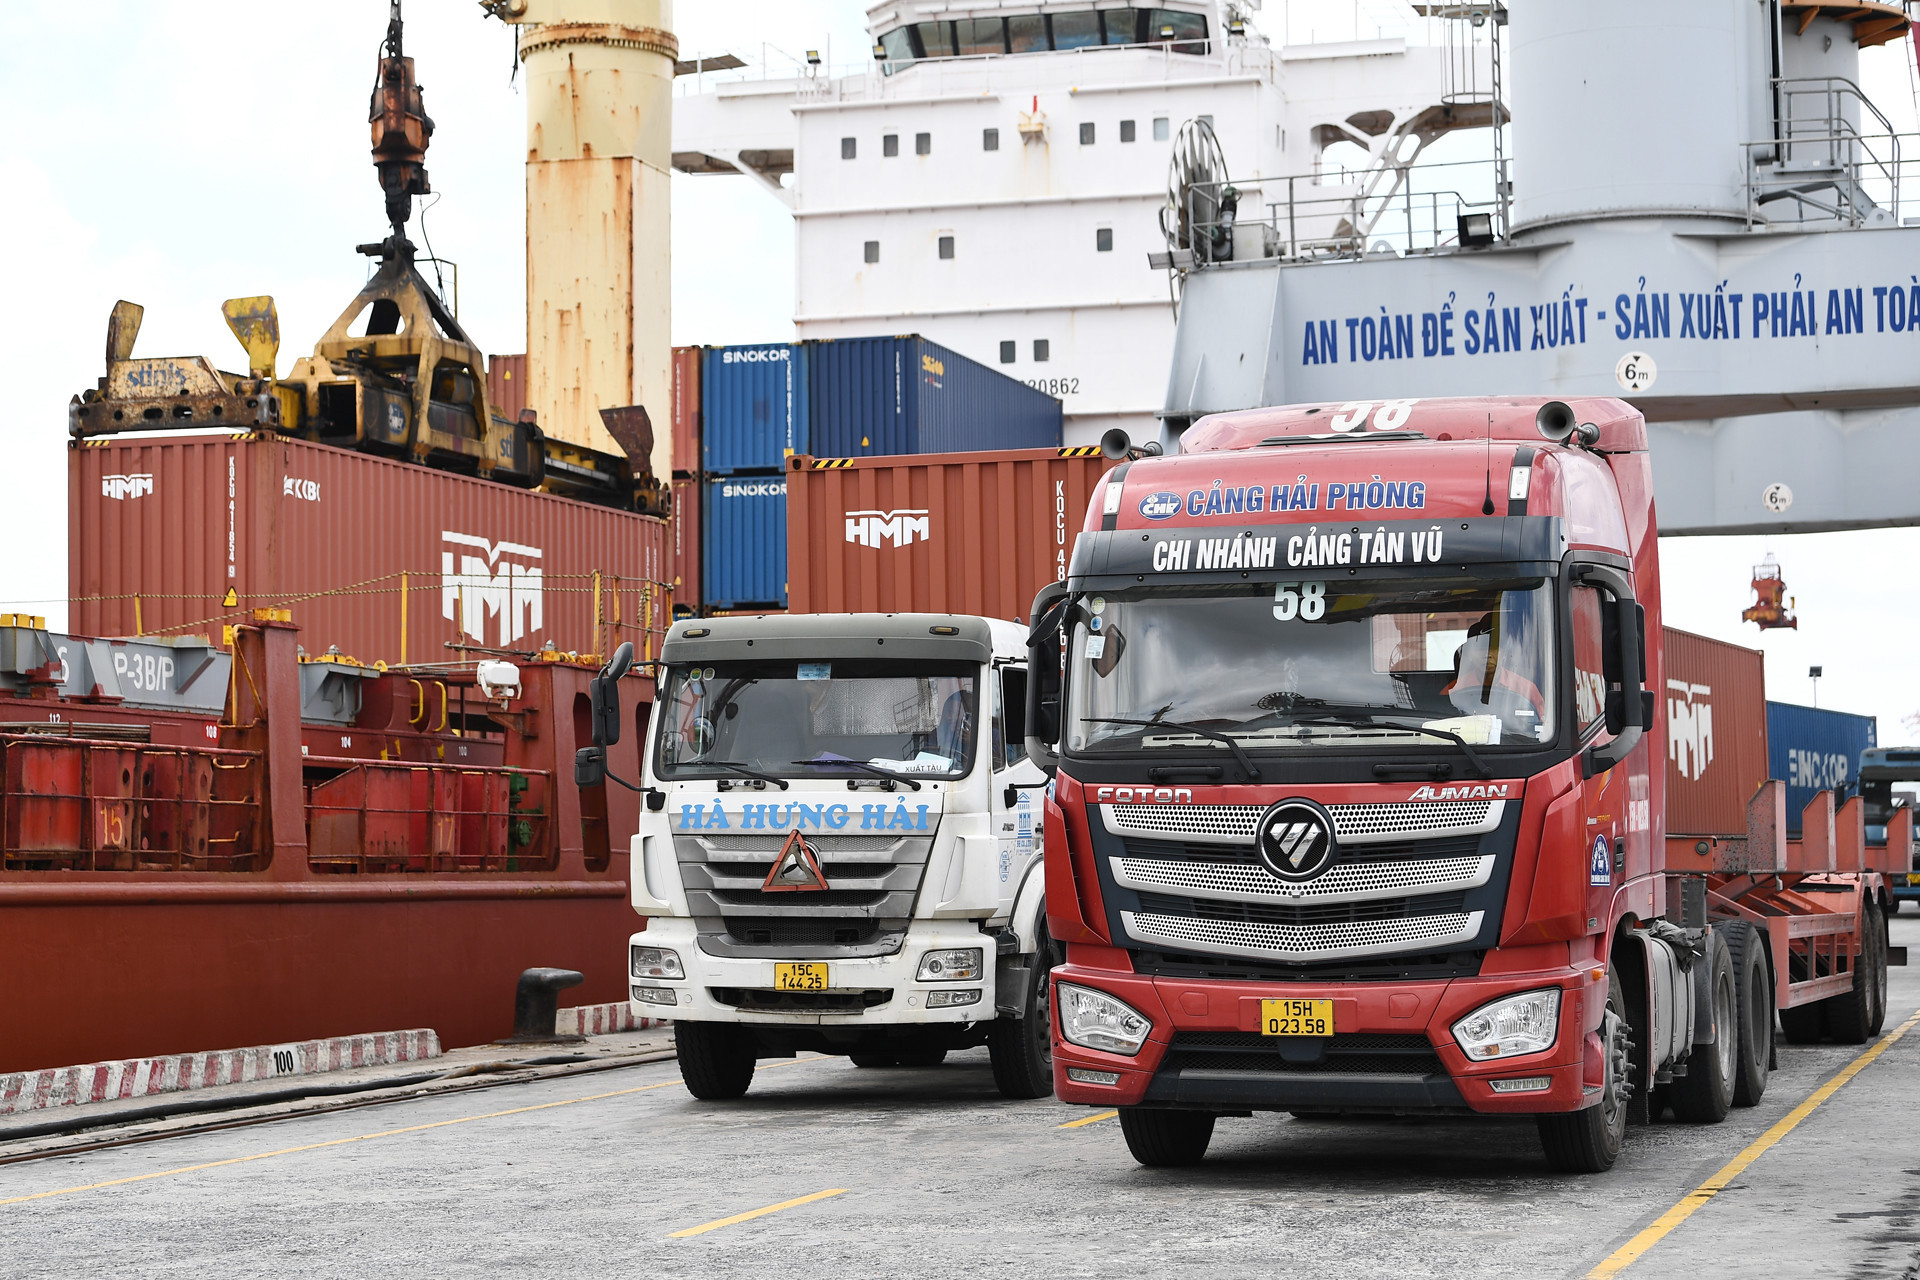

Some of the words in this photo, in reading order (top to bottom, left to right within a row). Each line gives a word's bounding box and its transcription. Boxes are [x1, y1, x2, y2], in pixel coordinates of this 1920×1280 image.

[1303, 320, 1338, 365] AN
[1346, 306, 1414, 363] TOÀN
[1422, 291, 1456, 357] ĐỂ
[1464, 291, 1522, 355] SẢN
[1530, 284, 1588, 350] XUẤT
[1615, 276, 1671, 340] SẢN
[1679, 280, 1743, 340] XUẤT
[1752, 273, 1816, 338] PHẢI
[1825, 286, 1864, 335] AN
[723, 349, 790, 363] SINOKOR
[1330, 399, 1420, 432] 58
[102, 474, 153, 500] HMM
[723, 483, 787, 497] SINOKOR
[1186, 479, 1265, 517] CẢNG
[1270, 475, 1318, 512] HẢI
[1326, 475, 1426, 510] PHÒNG
[1056, 480, 1065, 545] KOCU
[846, 509, 929, 549] HMM
[1153, 540, 1191, 572] CHI
[1196, 533, 1277, 569] NHÁNH
[1287, 527, 1351, 567] CẢNG
[1359, 527, 1404, 564] TÂN
[1411, 526, 1443, 563] VŨ
[442, 531, 543, 646] HMM
[1273, 581, 1326, 621] 58
[1098, 782, 1192, 803] FOTON
[1407, 785, 1508, 801] AUMAN
[100, 806, 123, 845] 15
[679, 798, 730, 829] HÀ
[740, 801, 850, 829] HƯNG
[860, 795, 929, 830] HẢI
[782, 977, 822, 989] 144.25
[792, 965, 812, 976] 15C
[1284, 1001, 1312, 1016] 15H
[1269, 1019, 1325, 1033] 023.58
[273, 1050, 294, 1074] 100
